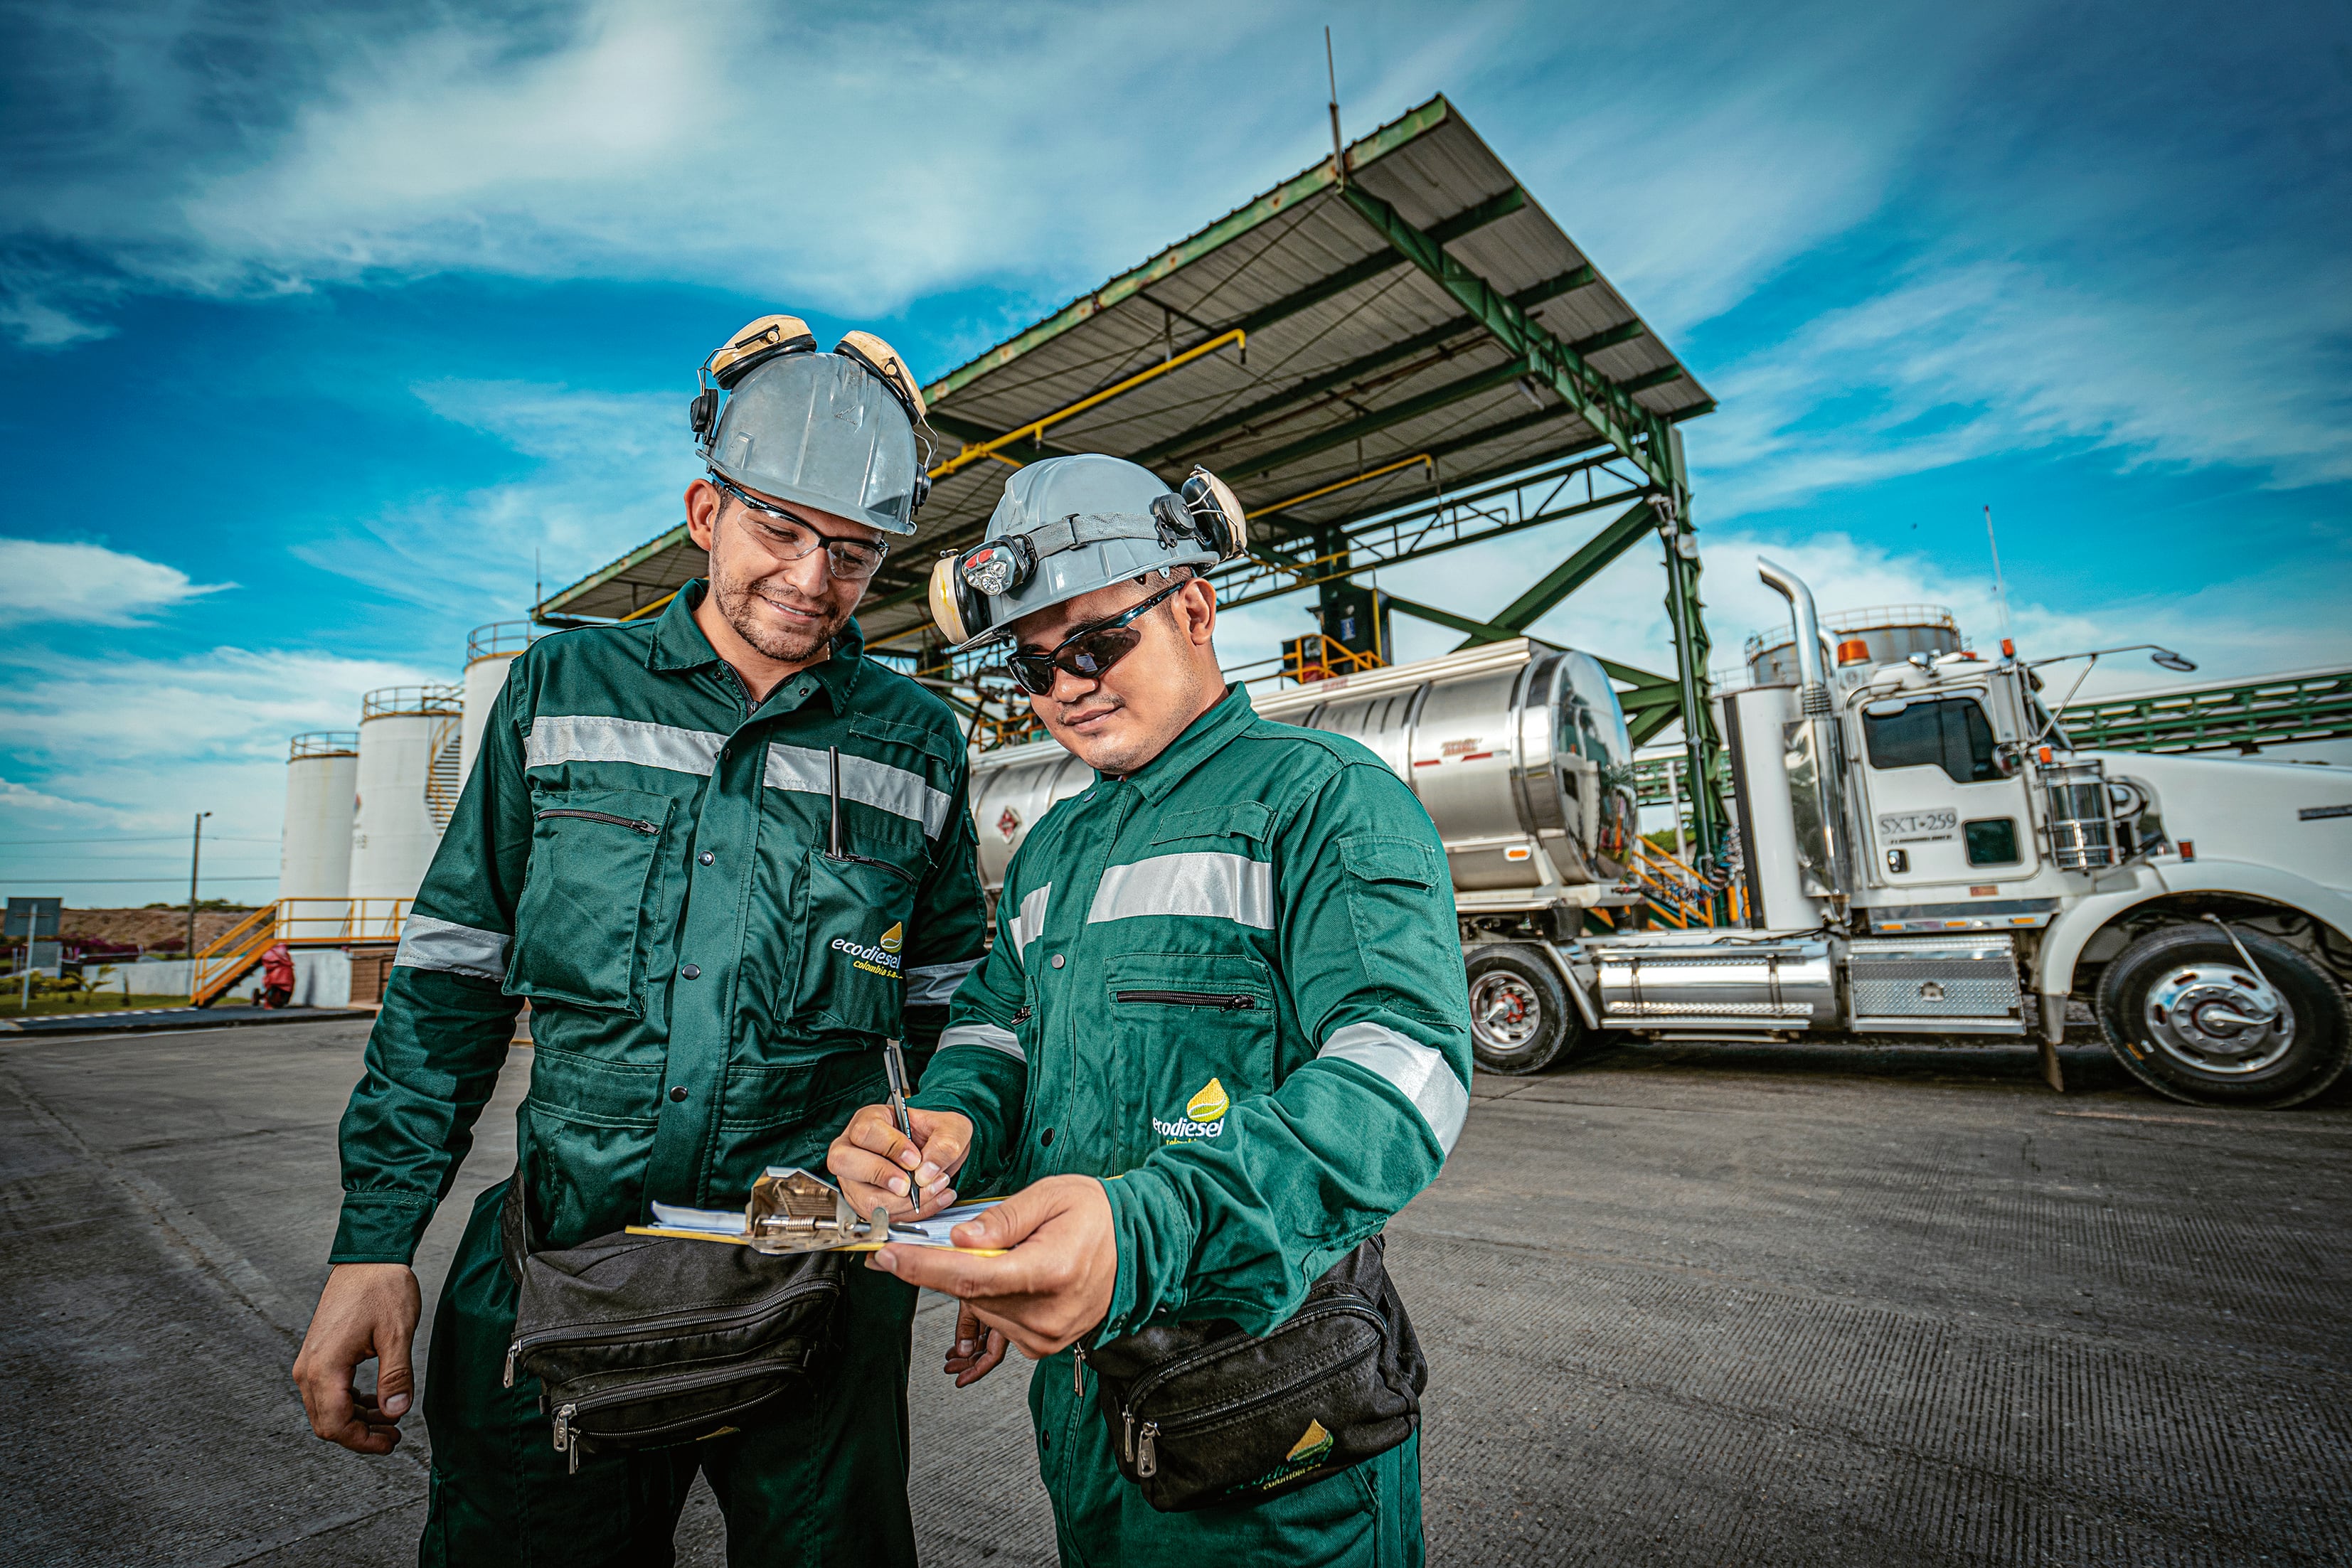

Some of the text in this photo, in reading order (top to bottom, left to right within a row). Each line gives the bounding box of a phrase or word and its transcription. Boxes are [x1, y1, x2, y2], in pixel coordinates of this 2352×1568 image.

[831, 939, 901, 969] ecodiesel
[853, 960, 887, 976] colombia
[1153, 1116, 1225, 1137] ecodiesel
